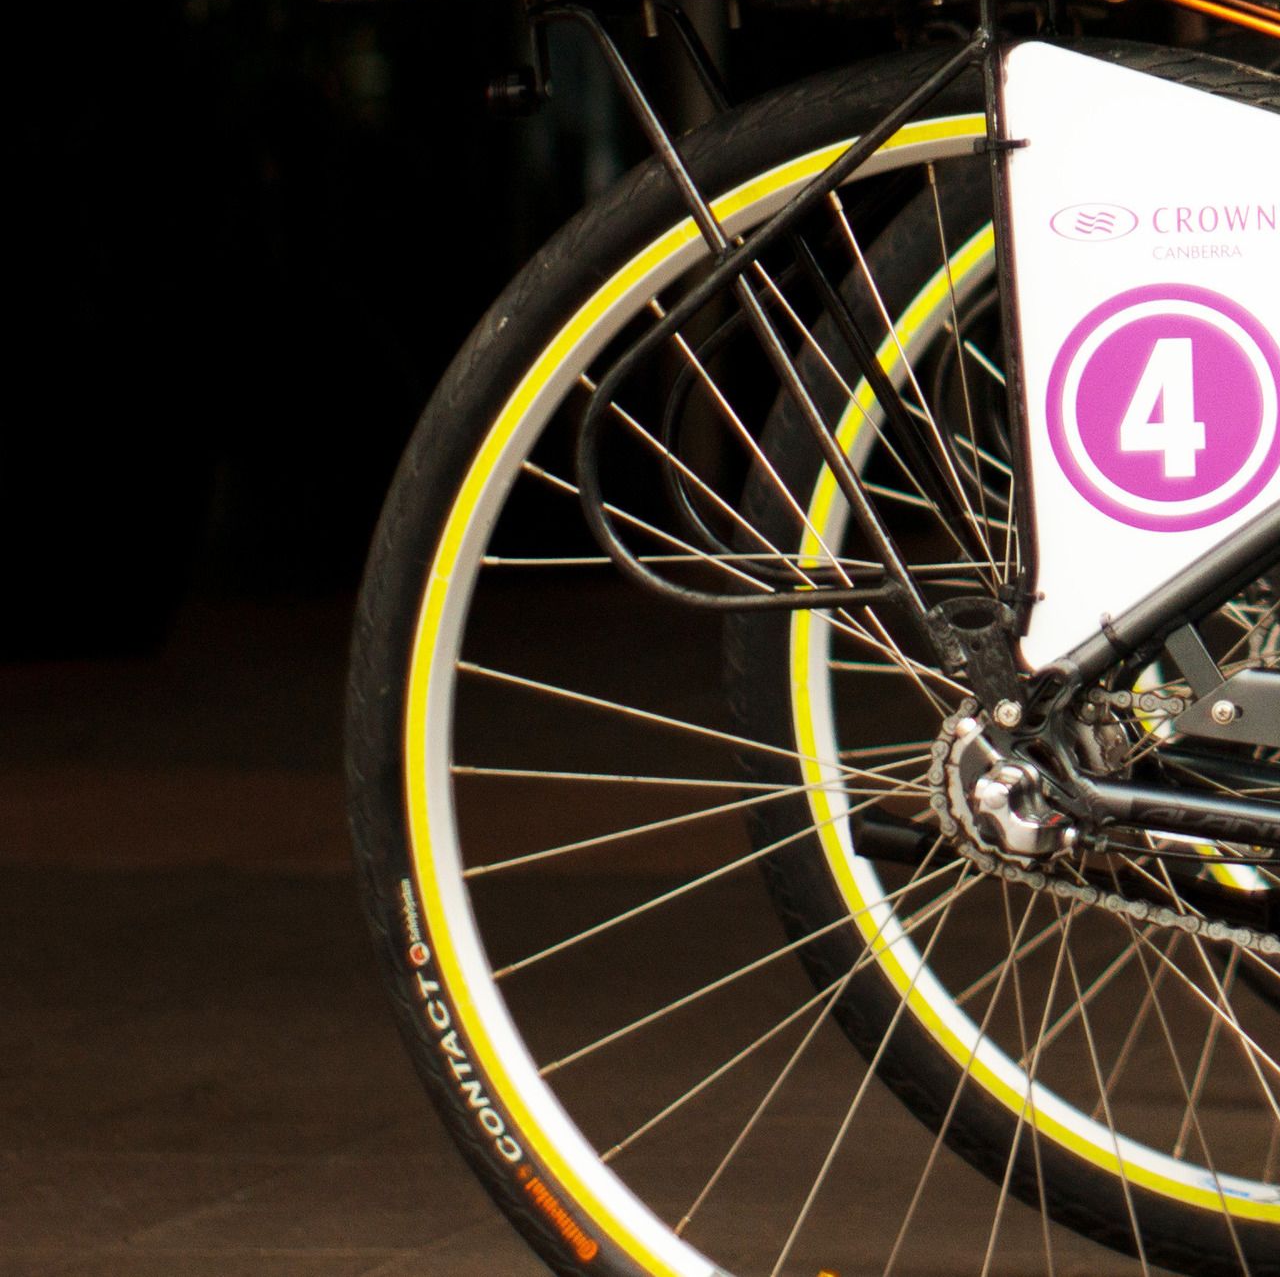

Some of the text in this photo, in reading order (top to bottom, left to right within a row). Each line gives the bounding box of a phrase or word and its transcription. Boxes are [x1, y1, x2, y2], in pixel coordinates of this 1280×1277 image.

[1152, 243, 1243, 261] CANBERRA
[1119, 337, 1206, 478] 4
[416, 970, 523, 1163] CONTACT
